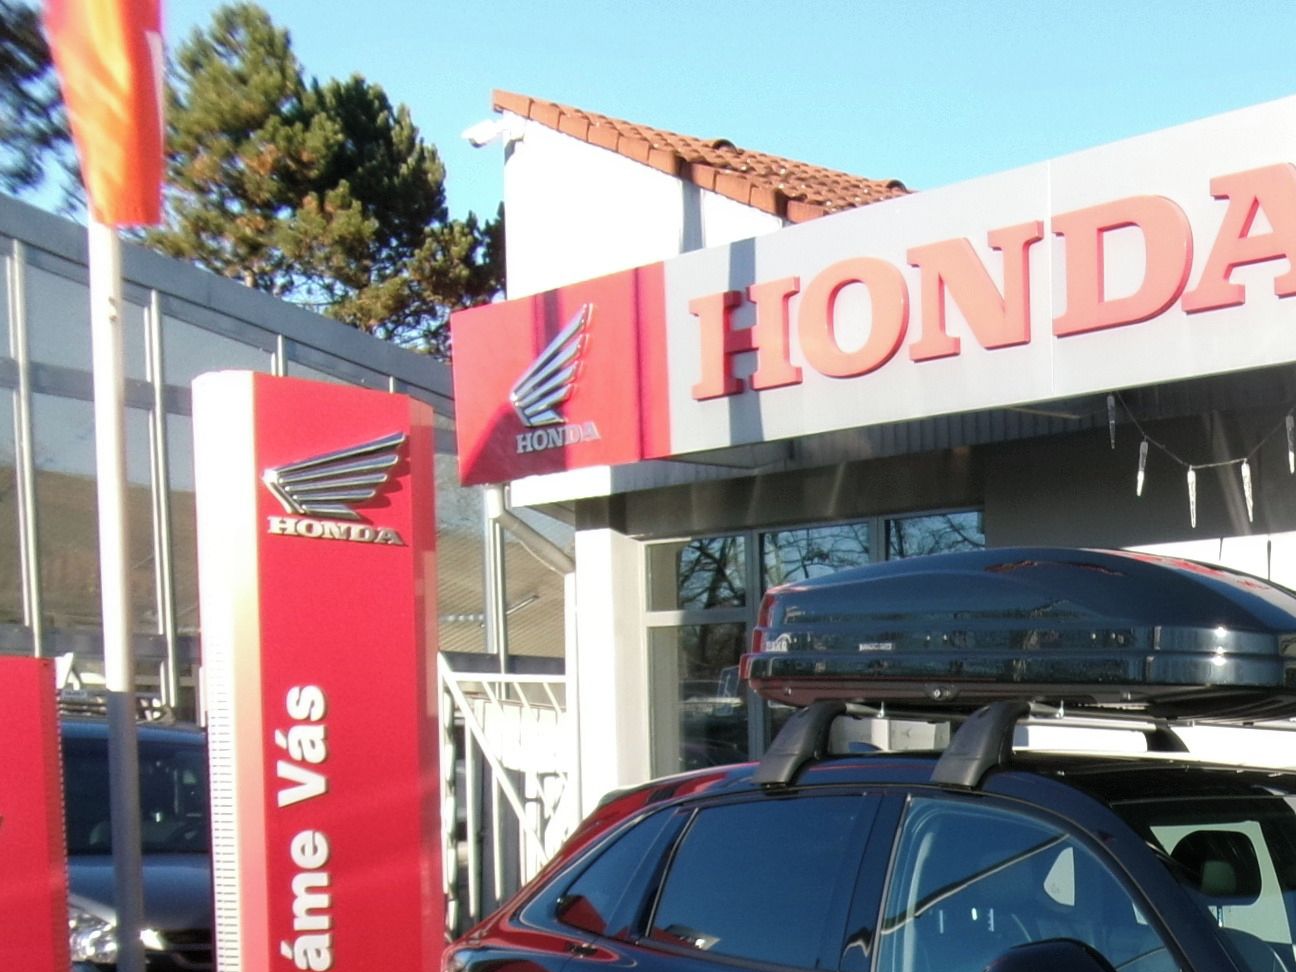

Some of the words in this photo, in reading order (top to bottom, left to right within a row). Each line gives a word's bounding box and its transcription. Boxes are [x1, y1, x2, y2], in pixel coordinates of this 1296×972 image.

[516, 420, 601, 454] HONDA
[267, 515, 407, 546] HONDA
[275, 684, 328, 807] Vás
